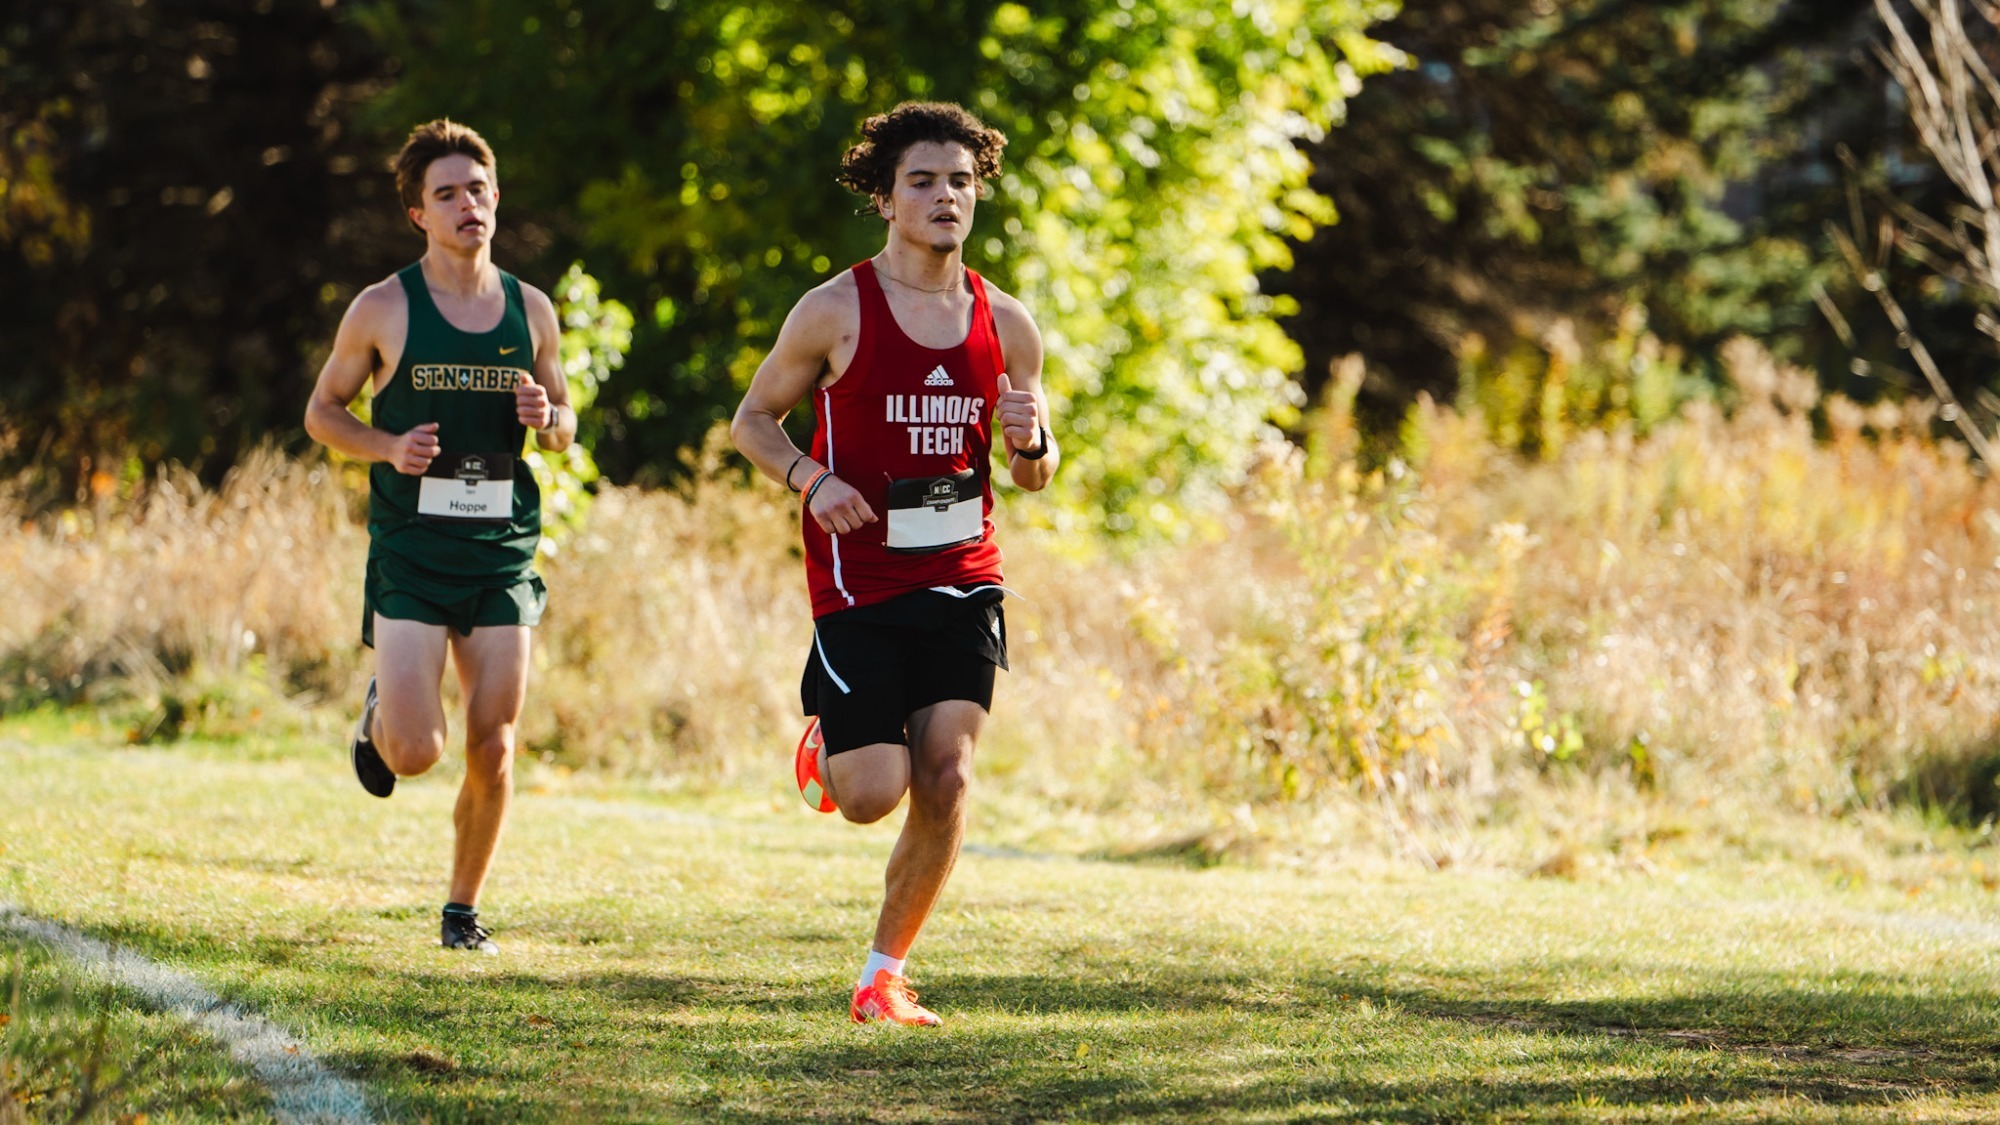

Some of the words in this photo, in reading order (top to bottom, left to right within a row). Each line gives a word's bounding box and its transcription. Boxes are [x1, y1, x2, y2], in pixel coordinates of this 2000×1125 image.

[924, 378, 954, 386] adidas
[886, 394, 985, 425] ILLINOIS
[907, 426, 964, 455] TECH
[449, 501, 487, 513] Hoppe
